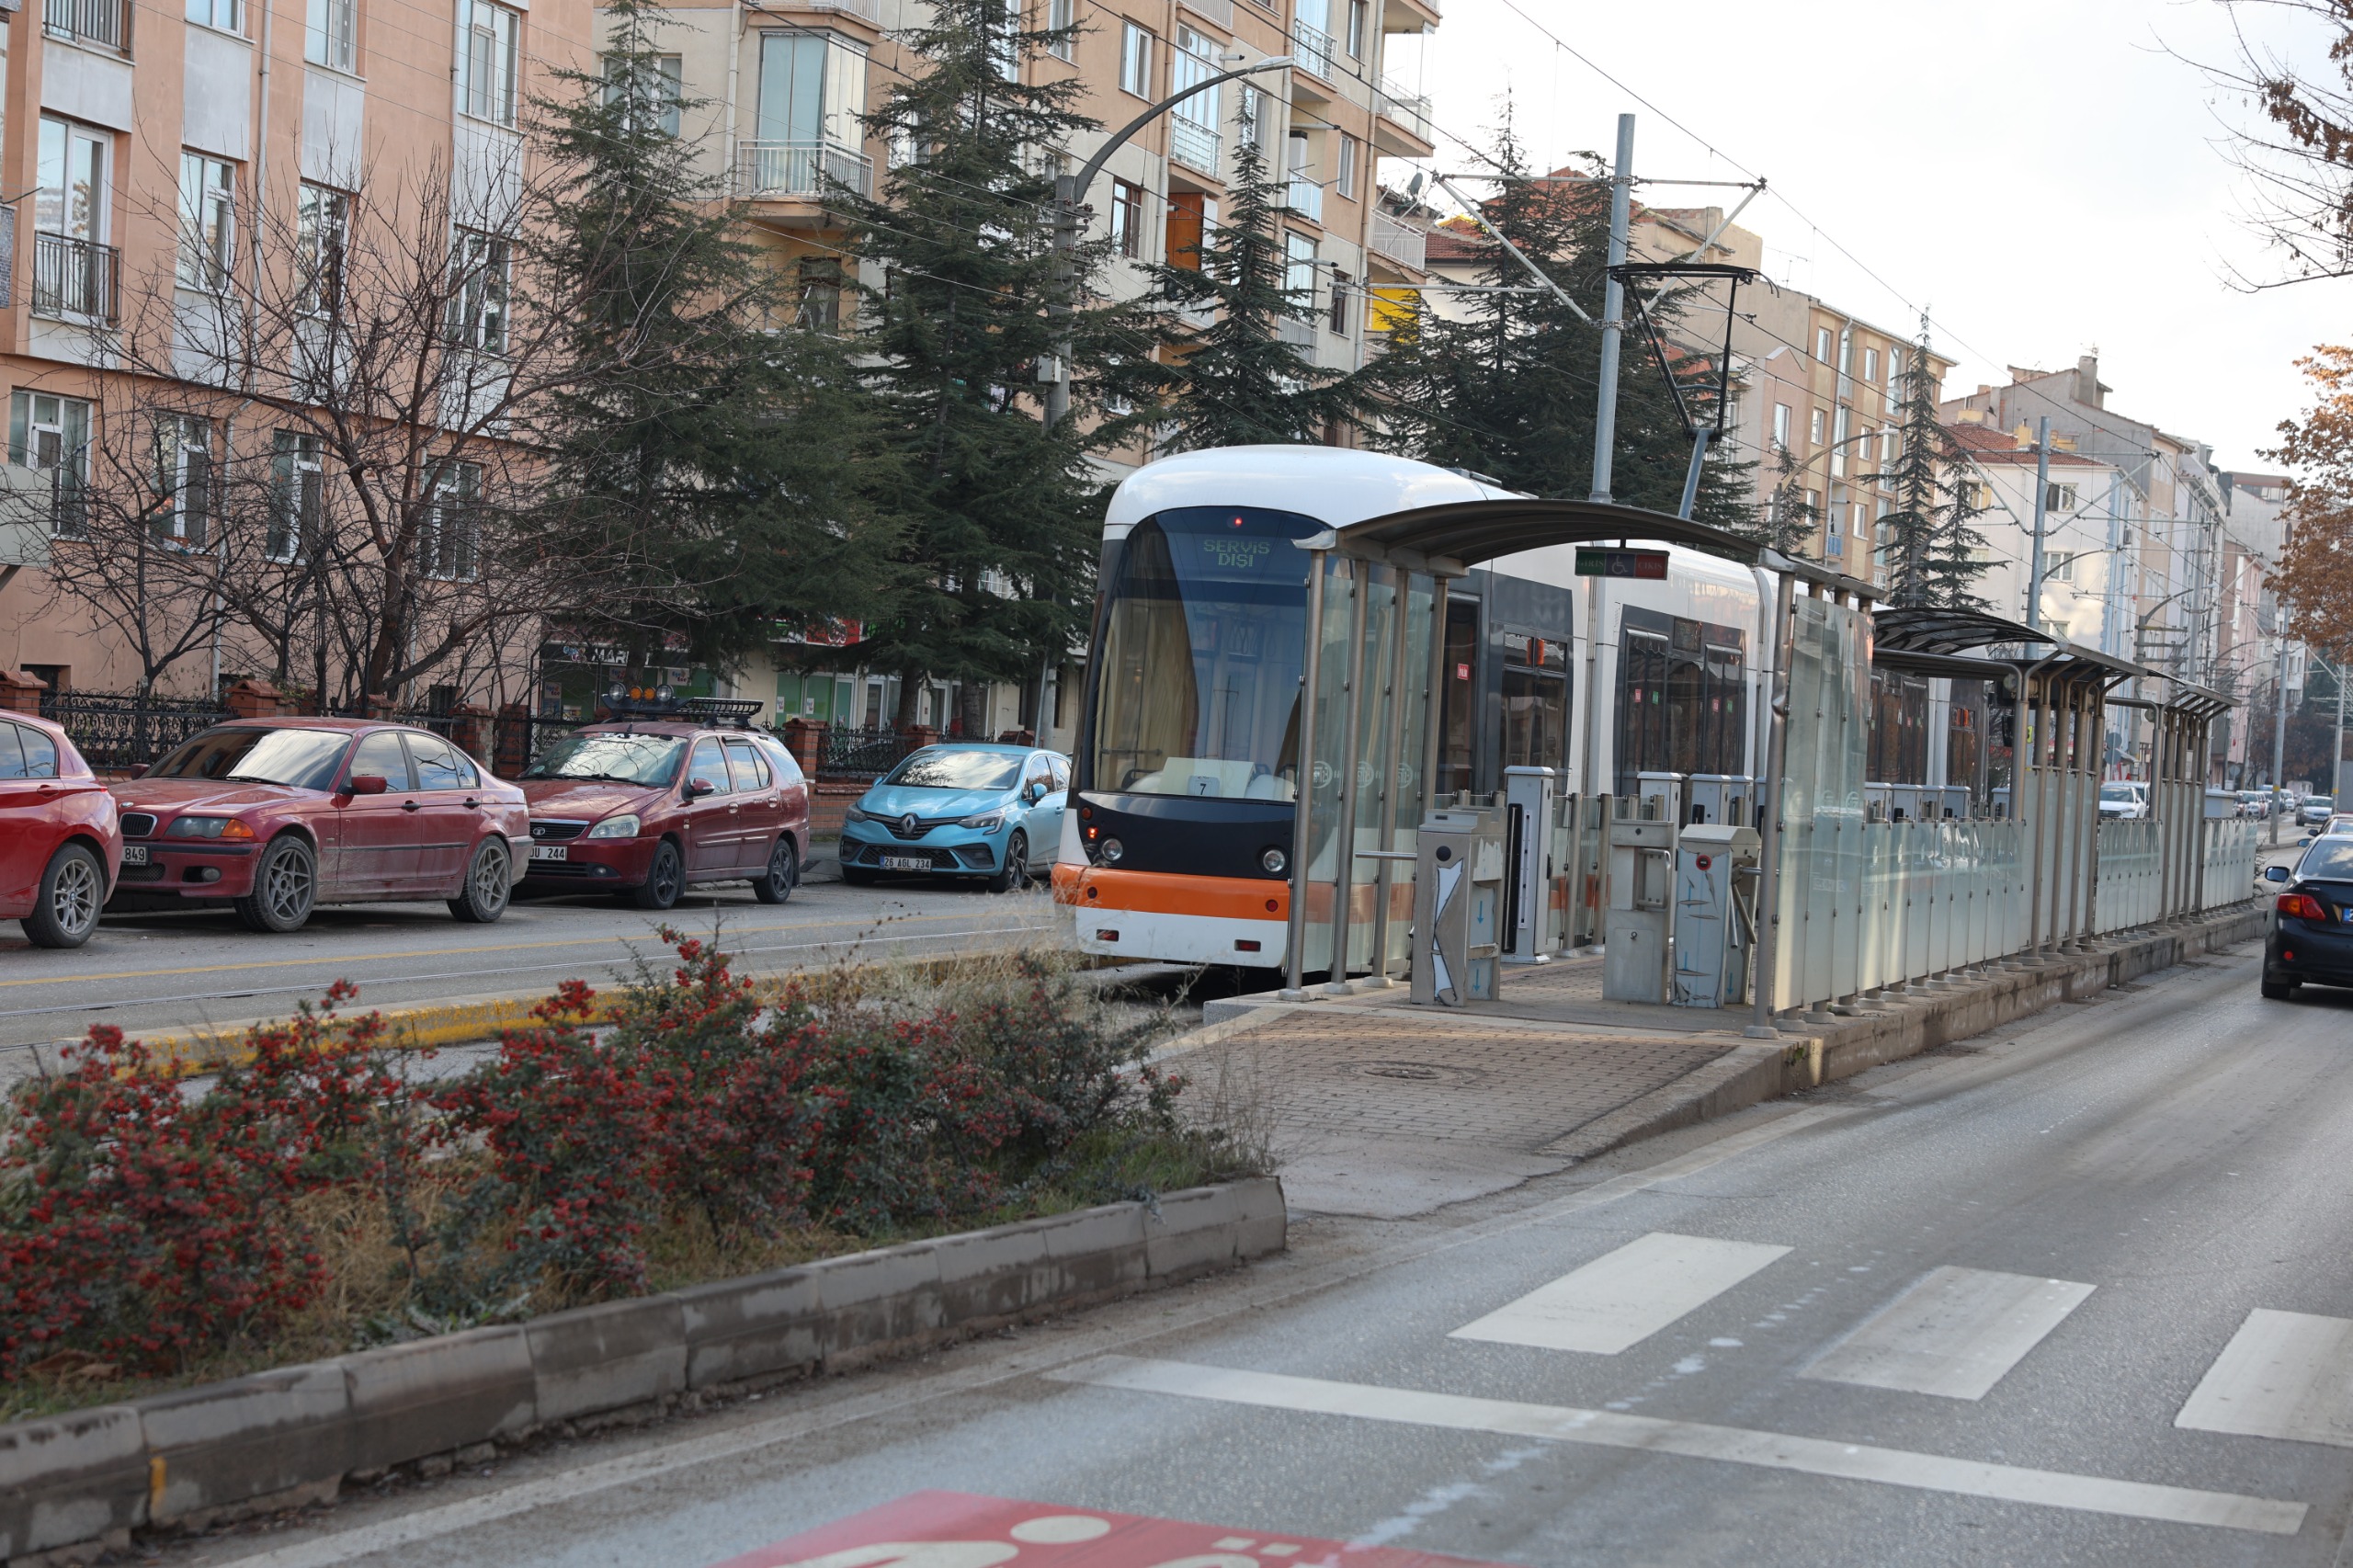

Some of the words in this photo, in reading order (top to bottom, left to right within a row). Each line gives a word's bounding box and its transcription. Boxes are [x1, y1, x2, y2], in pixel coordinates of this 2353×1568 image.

[1199, 782, 1207, 796] 7
[125, 847, 145, 861] 849
[547, 847, 564, 858] 244
[884, 858, 894, 867] 26
[897, 858, 912, 868] AGL
[915, 859, 930, 869] 234
